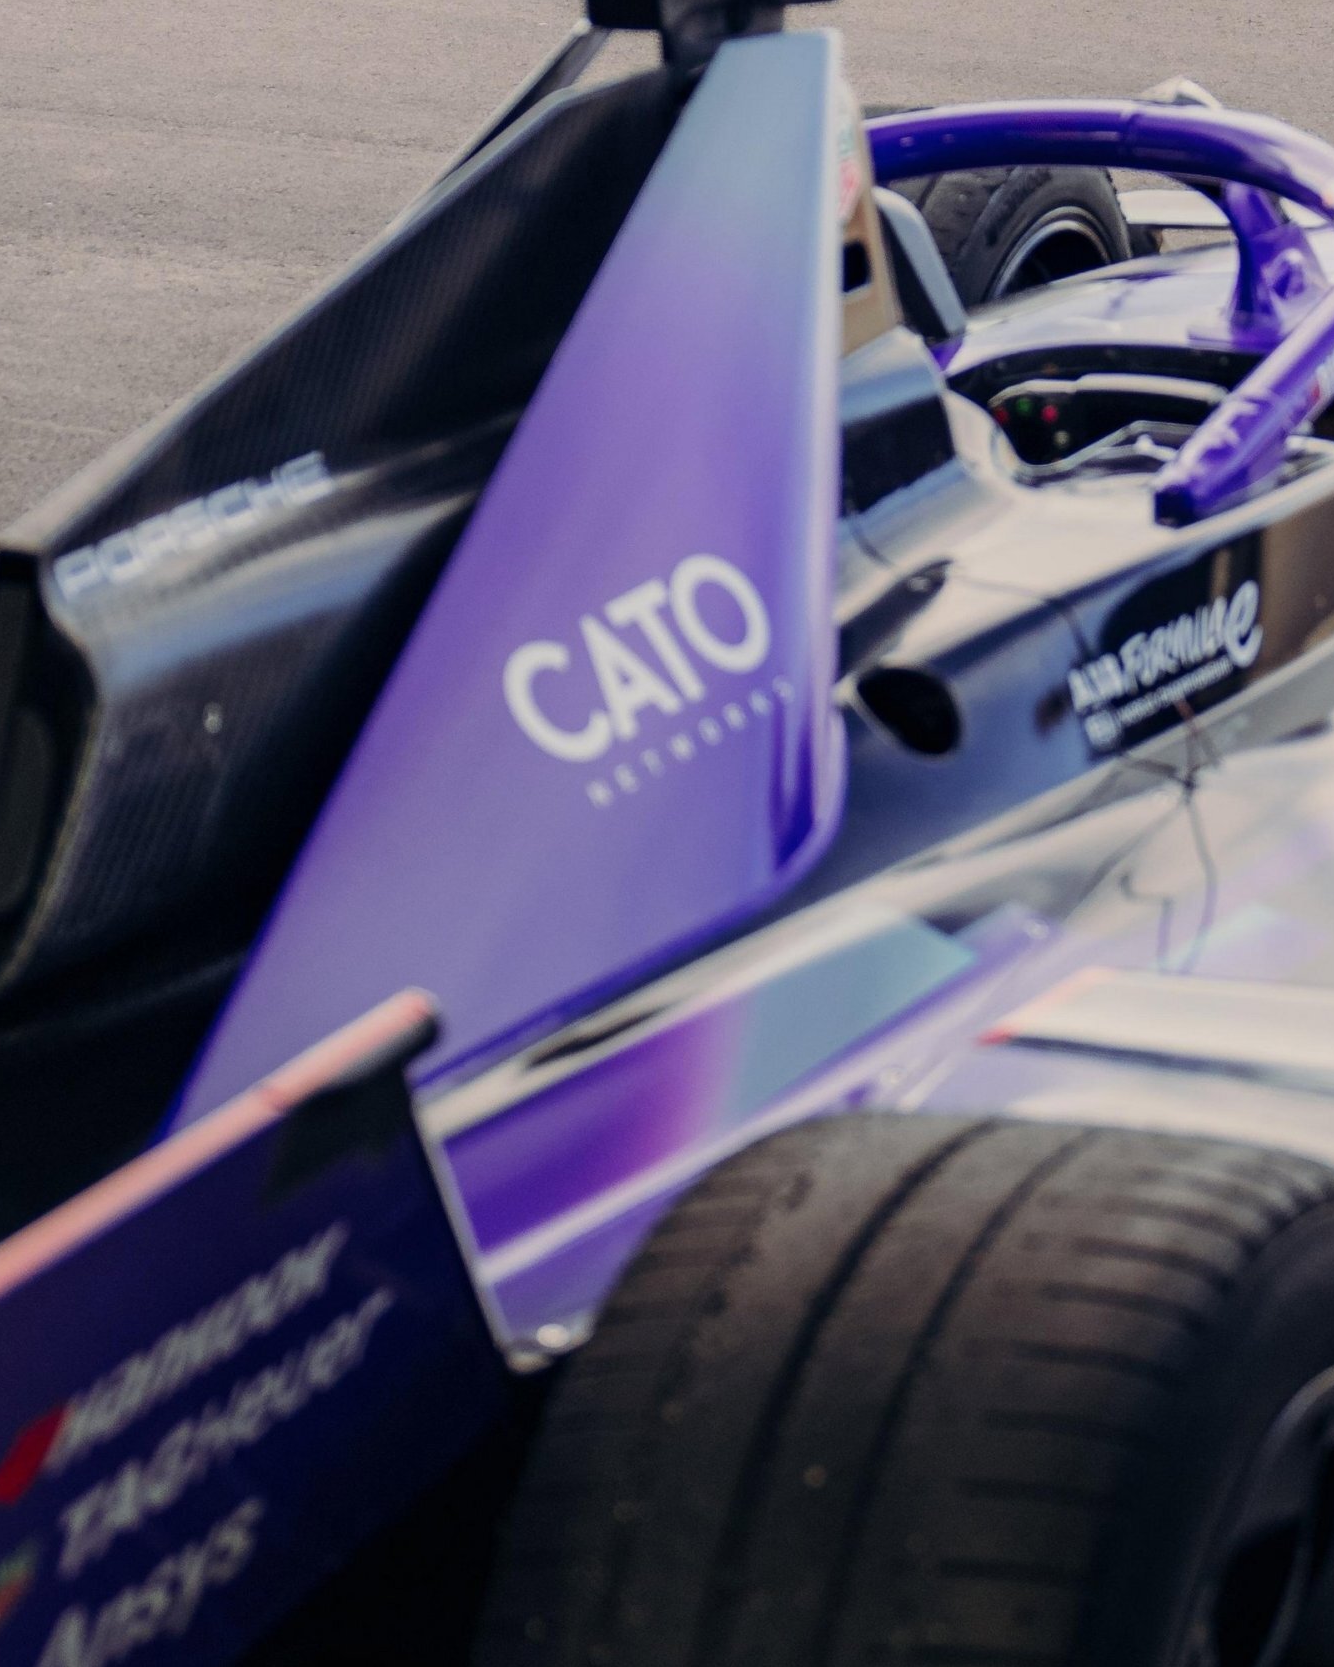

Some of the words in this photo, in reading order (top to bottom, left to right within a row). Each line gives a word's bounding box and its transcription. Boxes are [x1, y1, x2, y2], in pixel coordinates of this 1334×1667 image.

[54, 450, 333, 600] PORSCHE
[504, 553, 770, 762] CATO
[585, 675, 795, 807] NETWORKS
